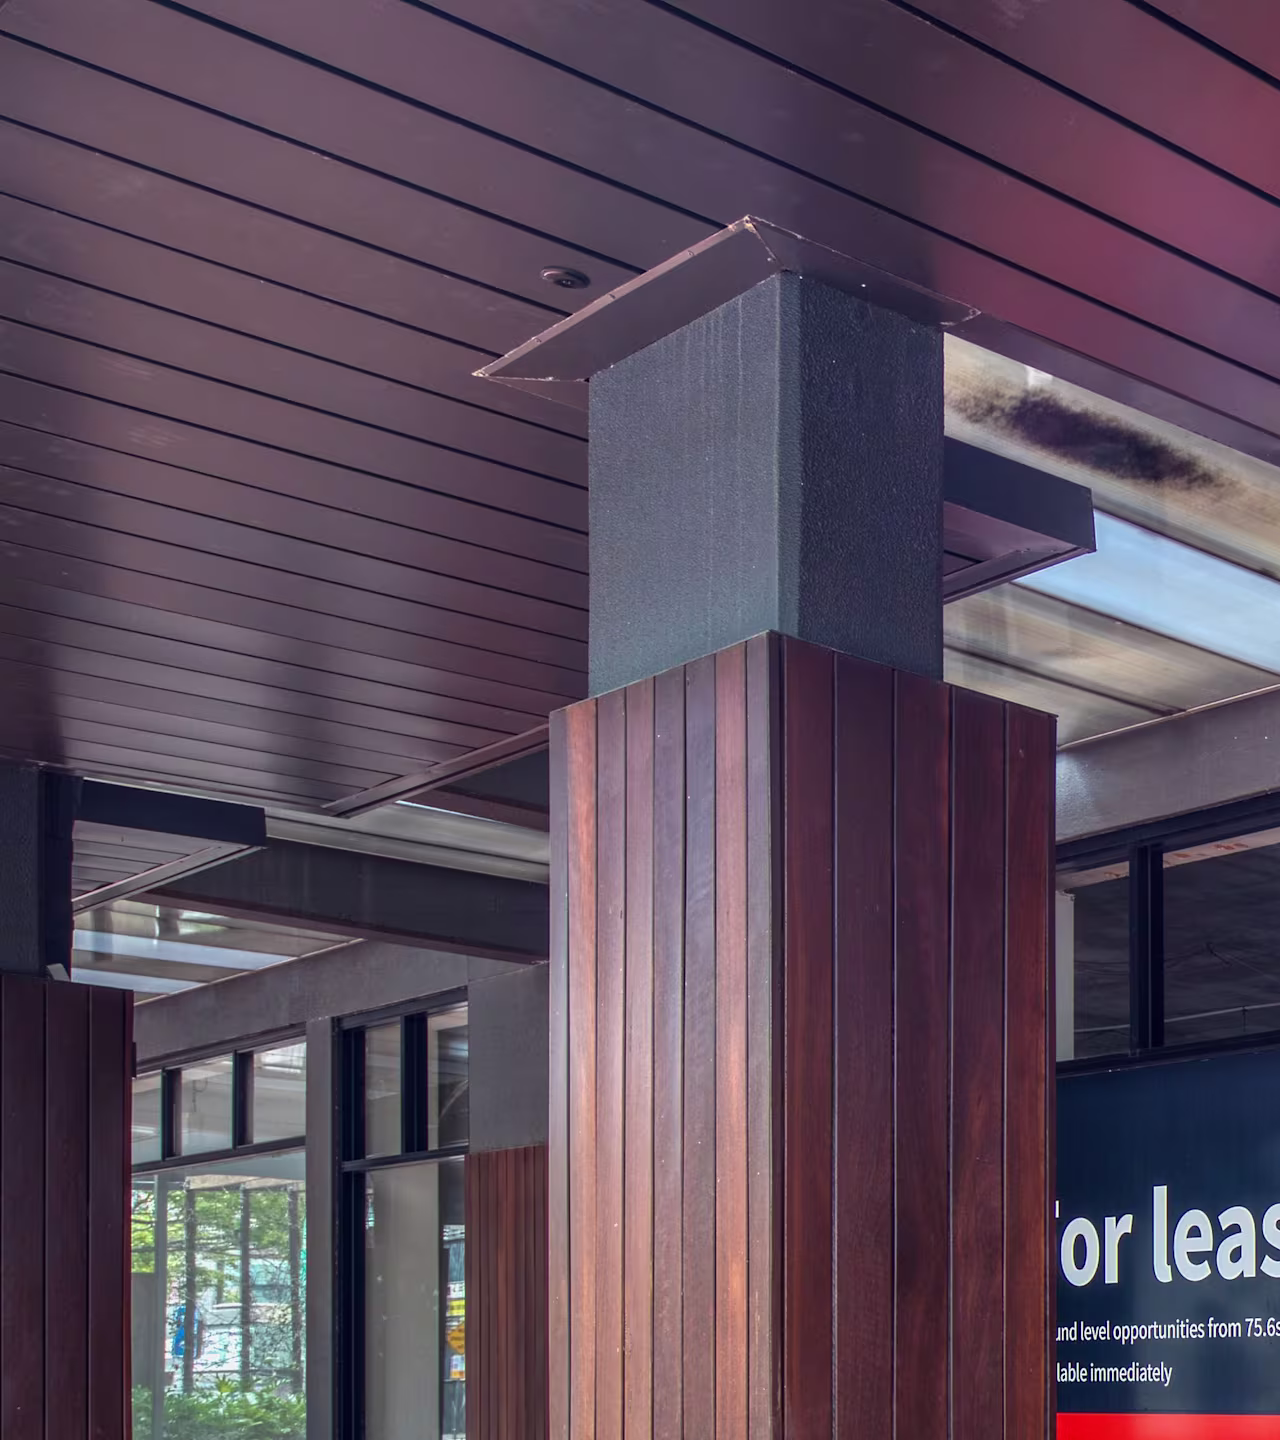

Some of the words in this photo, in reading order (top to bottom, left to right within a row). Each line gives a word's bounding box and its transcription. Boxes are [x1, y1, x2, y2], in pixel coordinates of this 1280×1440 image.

[1055, 1200, 1133, 1287] or
[1080, 1320, 1110, 1340] level
[1113, 1318, 1205, 1345] opportunities
[1208, 1317, 1241, 1338] from
[1056, 1362, 1088, 1382] lable
[1090, 1361, 1172, 1387] immediately
